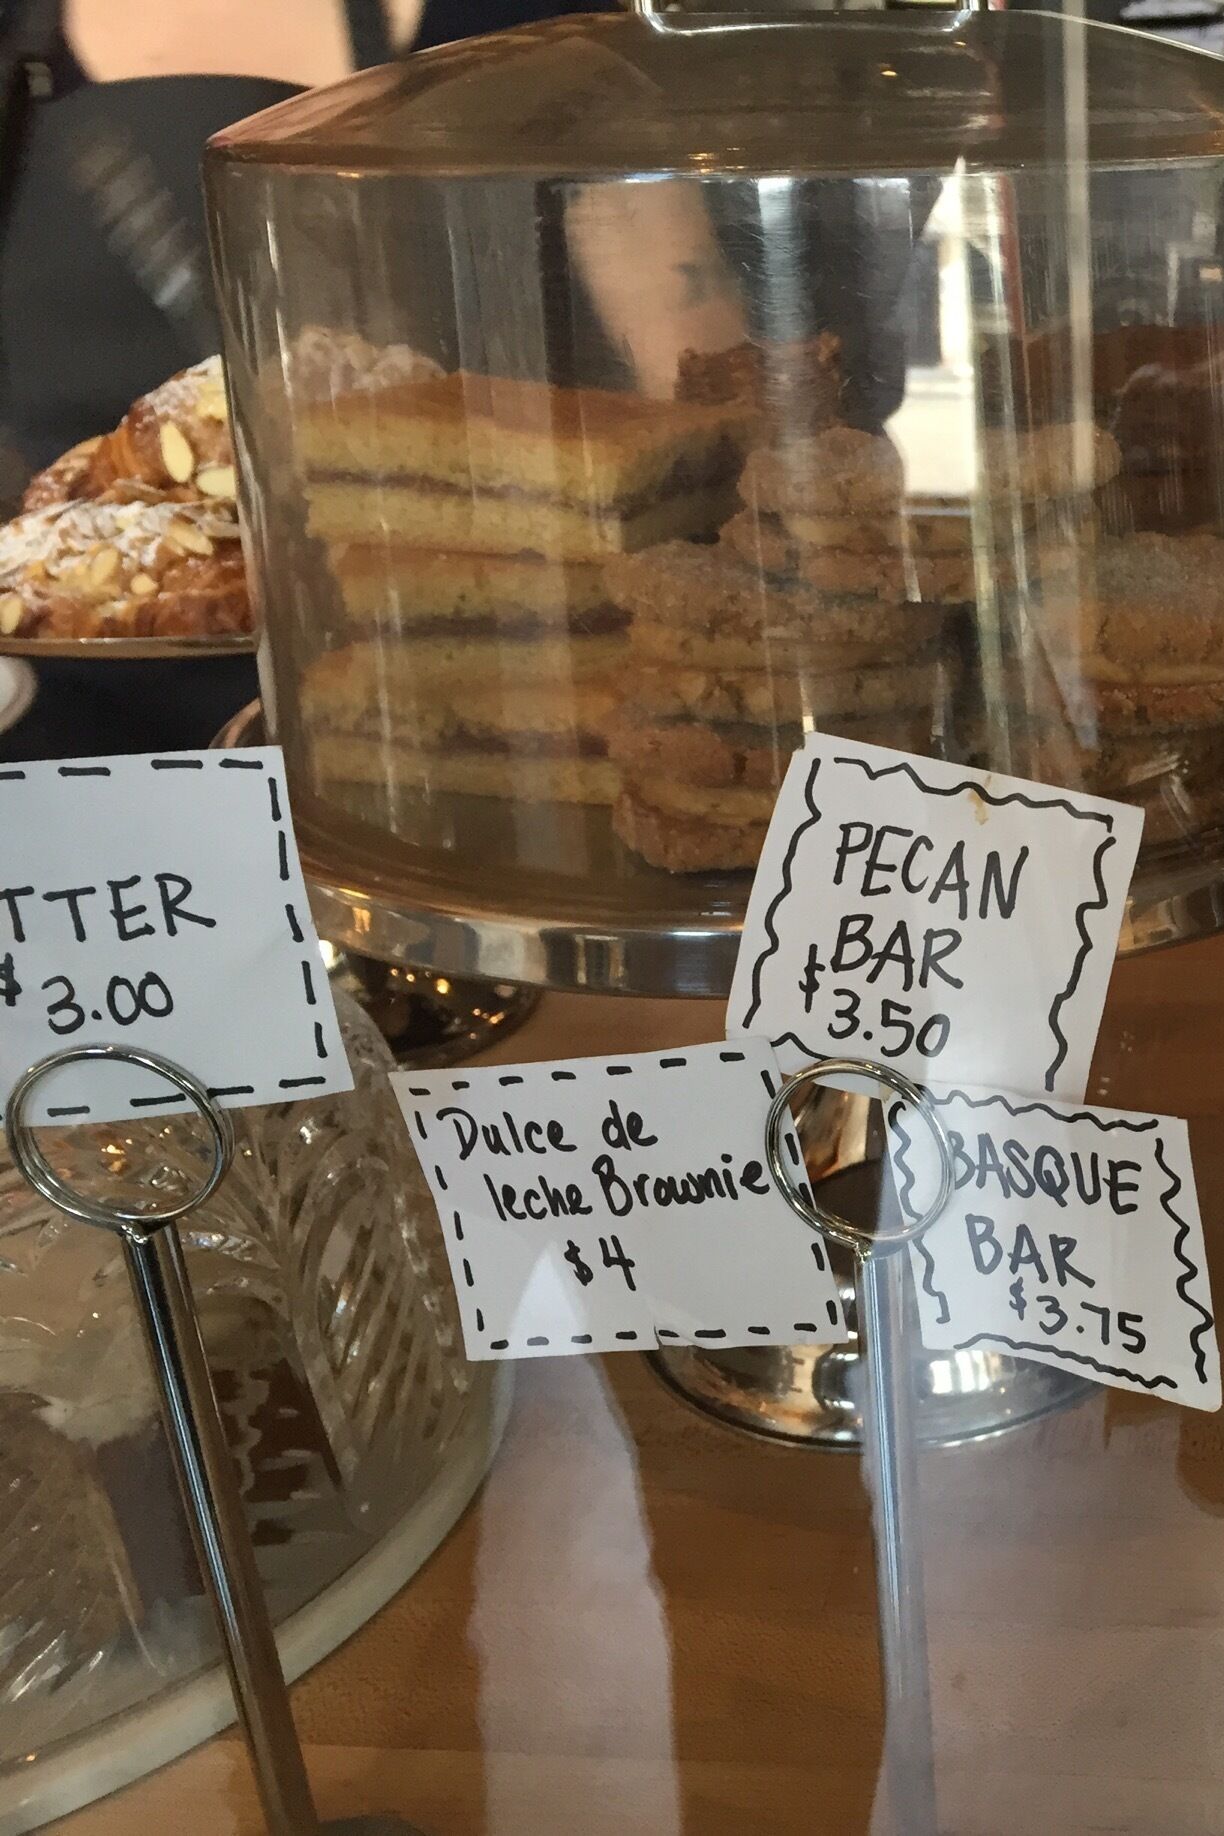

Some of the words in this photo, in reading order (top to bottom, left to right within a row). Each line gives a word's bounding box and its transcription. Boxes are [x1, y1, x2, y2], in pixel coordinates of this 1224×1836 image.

[833, 822, 1030, 920] PECAN
[831, 914, 964, 991] BAR
[799, 944, 951, 1058] $3.50
[436, 1107, 577, 1160] Dulce
[600, 1099, 658, 1150] de
[483, 1173, 593, 1221] leche
[592, 1154, 770, 1217] Brownie
[947, 1130, 1142, 1216] BASQUE
[564, 1235, 636, 1291] $4
[965, 1213, 1096, 1288] BAR
[1009, 1277, 1147, 1354] $3.75
